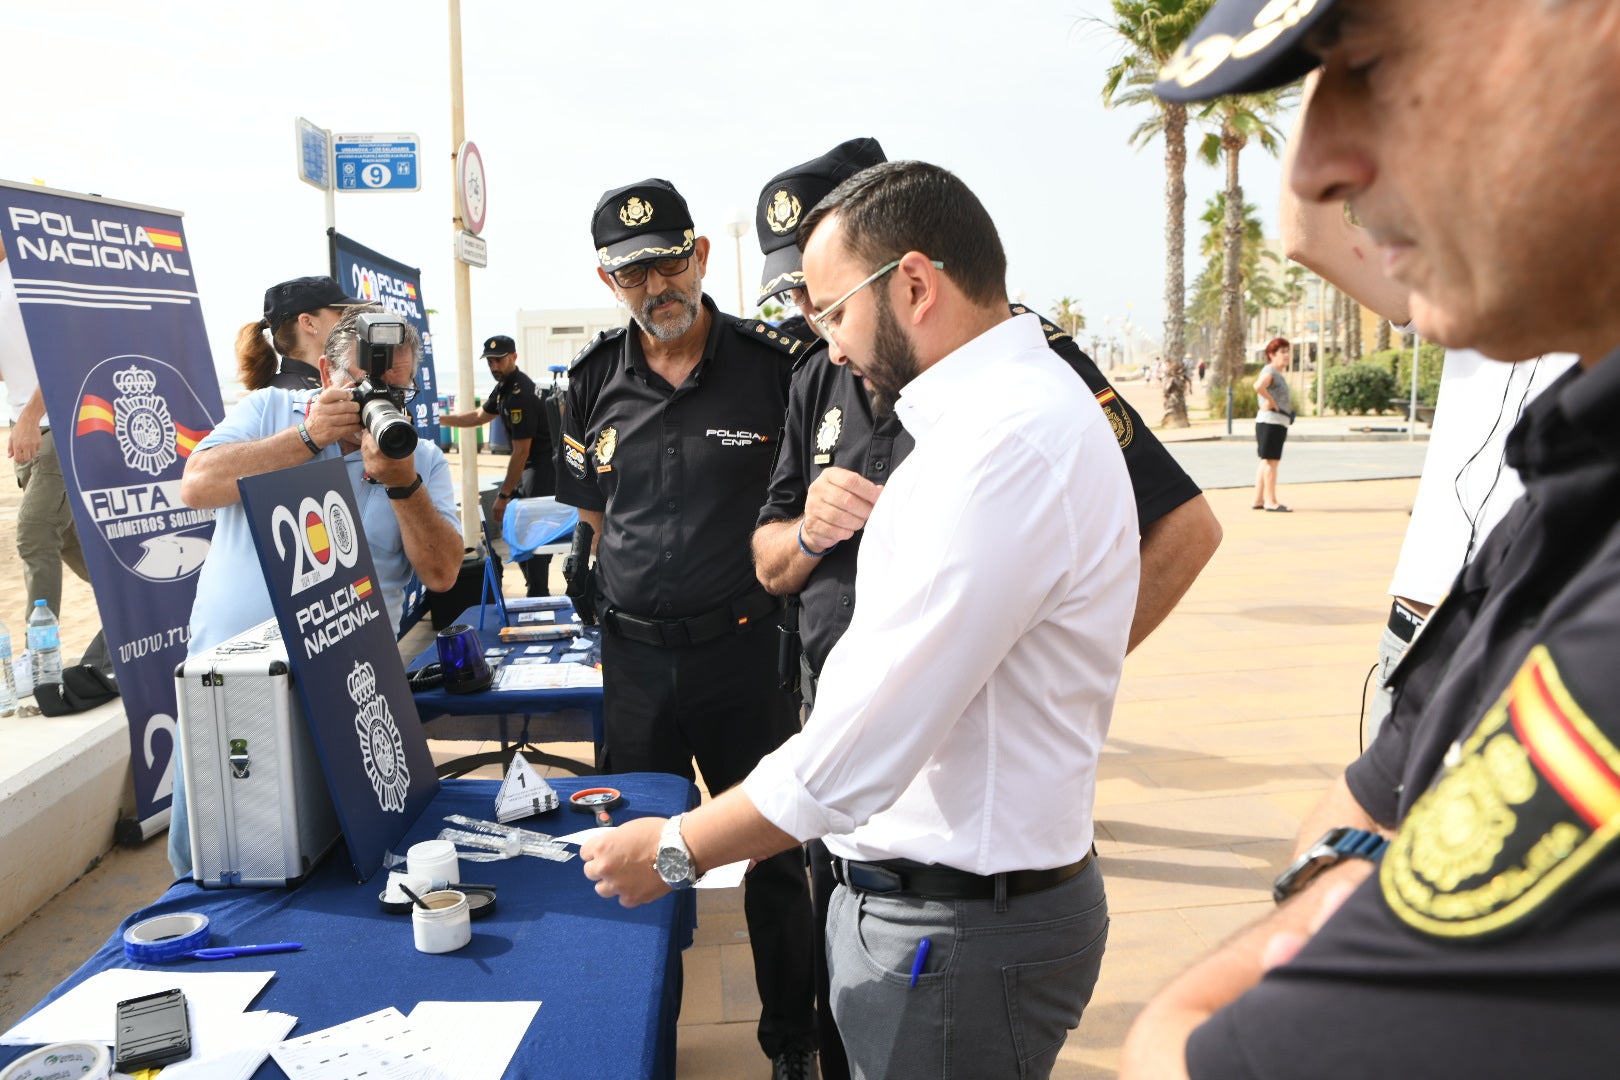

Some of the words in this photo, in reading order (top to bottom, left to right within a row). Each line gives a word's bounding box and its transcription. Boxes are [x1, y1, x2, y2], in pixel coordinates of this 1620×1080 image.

[370, 166, 383, 185] 9
[16, 235, 190, 276] NACIONAL
[90, 485, 170, 519] RUTA
[105, 515, 166, 540] KILÓMETROS
[271, 490, 359, 597] 200
[304, 601, 380, 660] NACIONAL
[517, 773, 526, 789] 1
